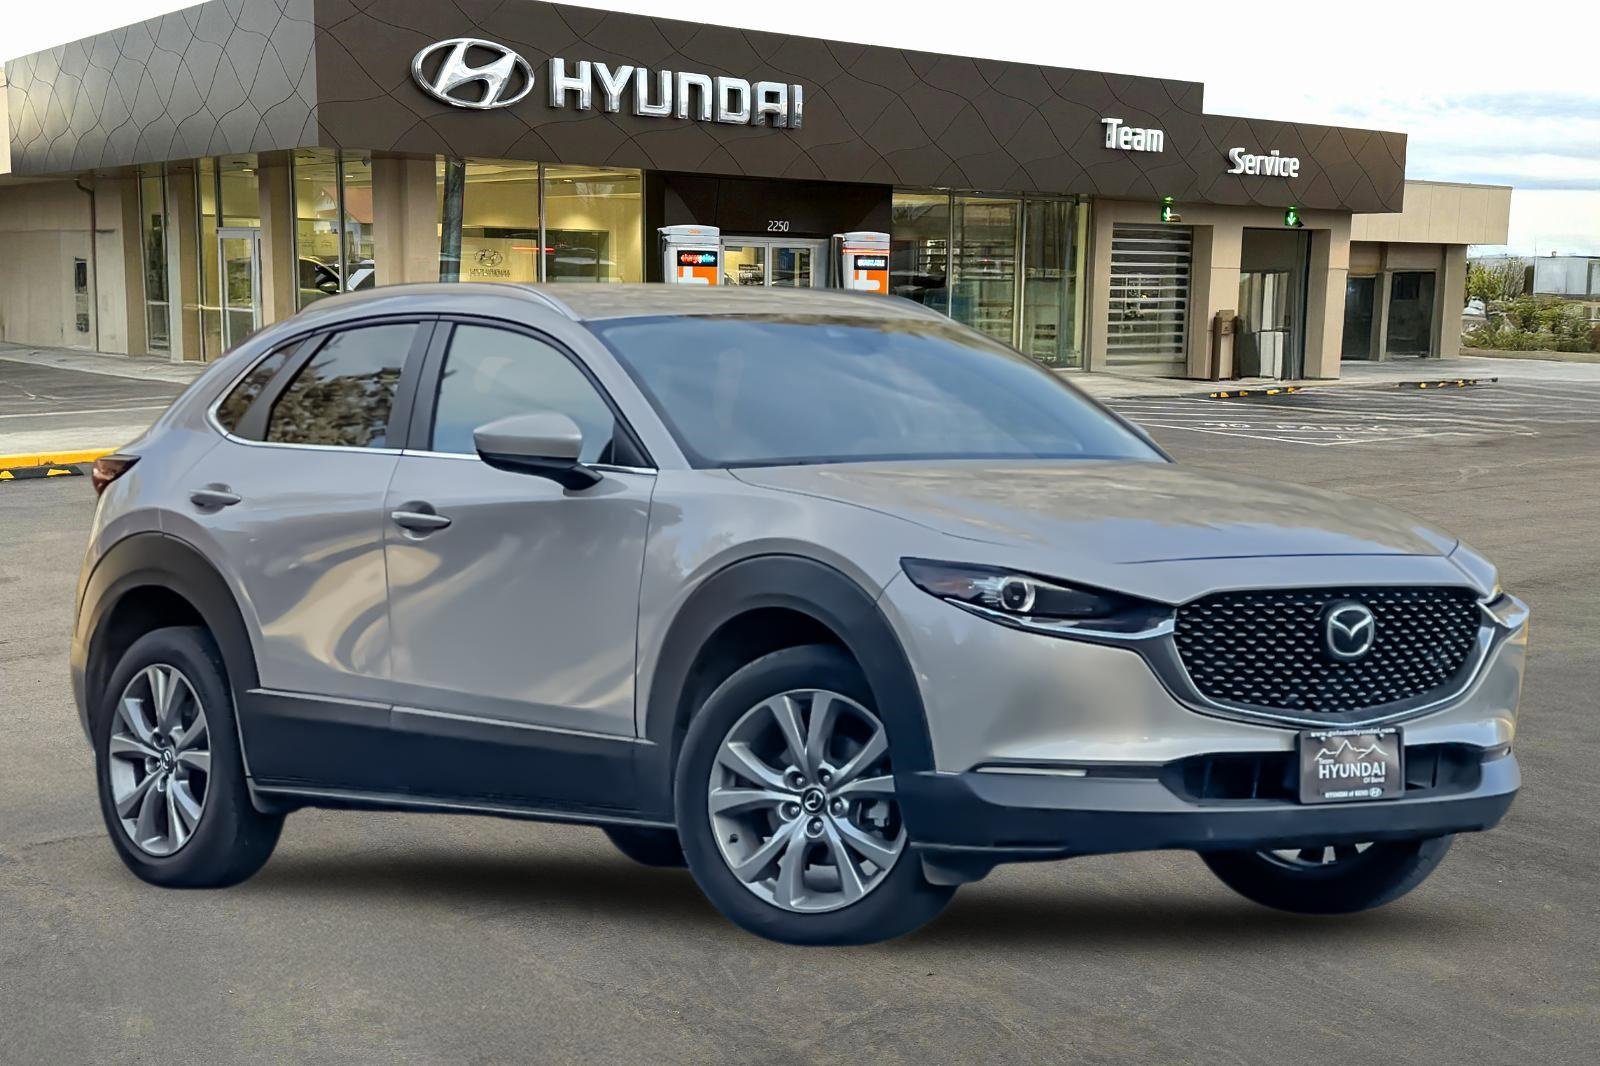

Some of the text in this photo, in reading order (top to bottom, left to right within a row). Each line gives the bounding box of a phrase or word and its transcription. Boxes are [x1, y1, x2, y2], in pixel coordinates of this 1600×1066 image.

[549, 57, 804, 129] HYUNDAI
[1101, 117, 1164, 153] Team
[1227, 147, 1300, 178] Service
[767, 220, 790, 232] 2250
[1318, 761, 1386, 779] HYUNDAI
